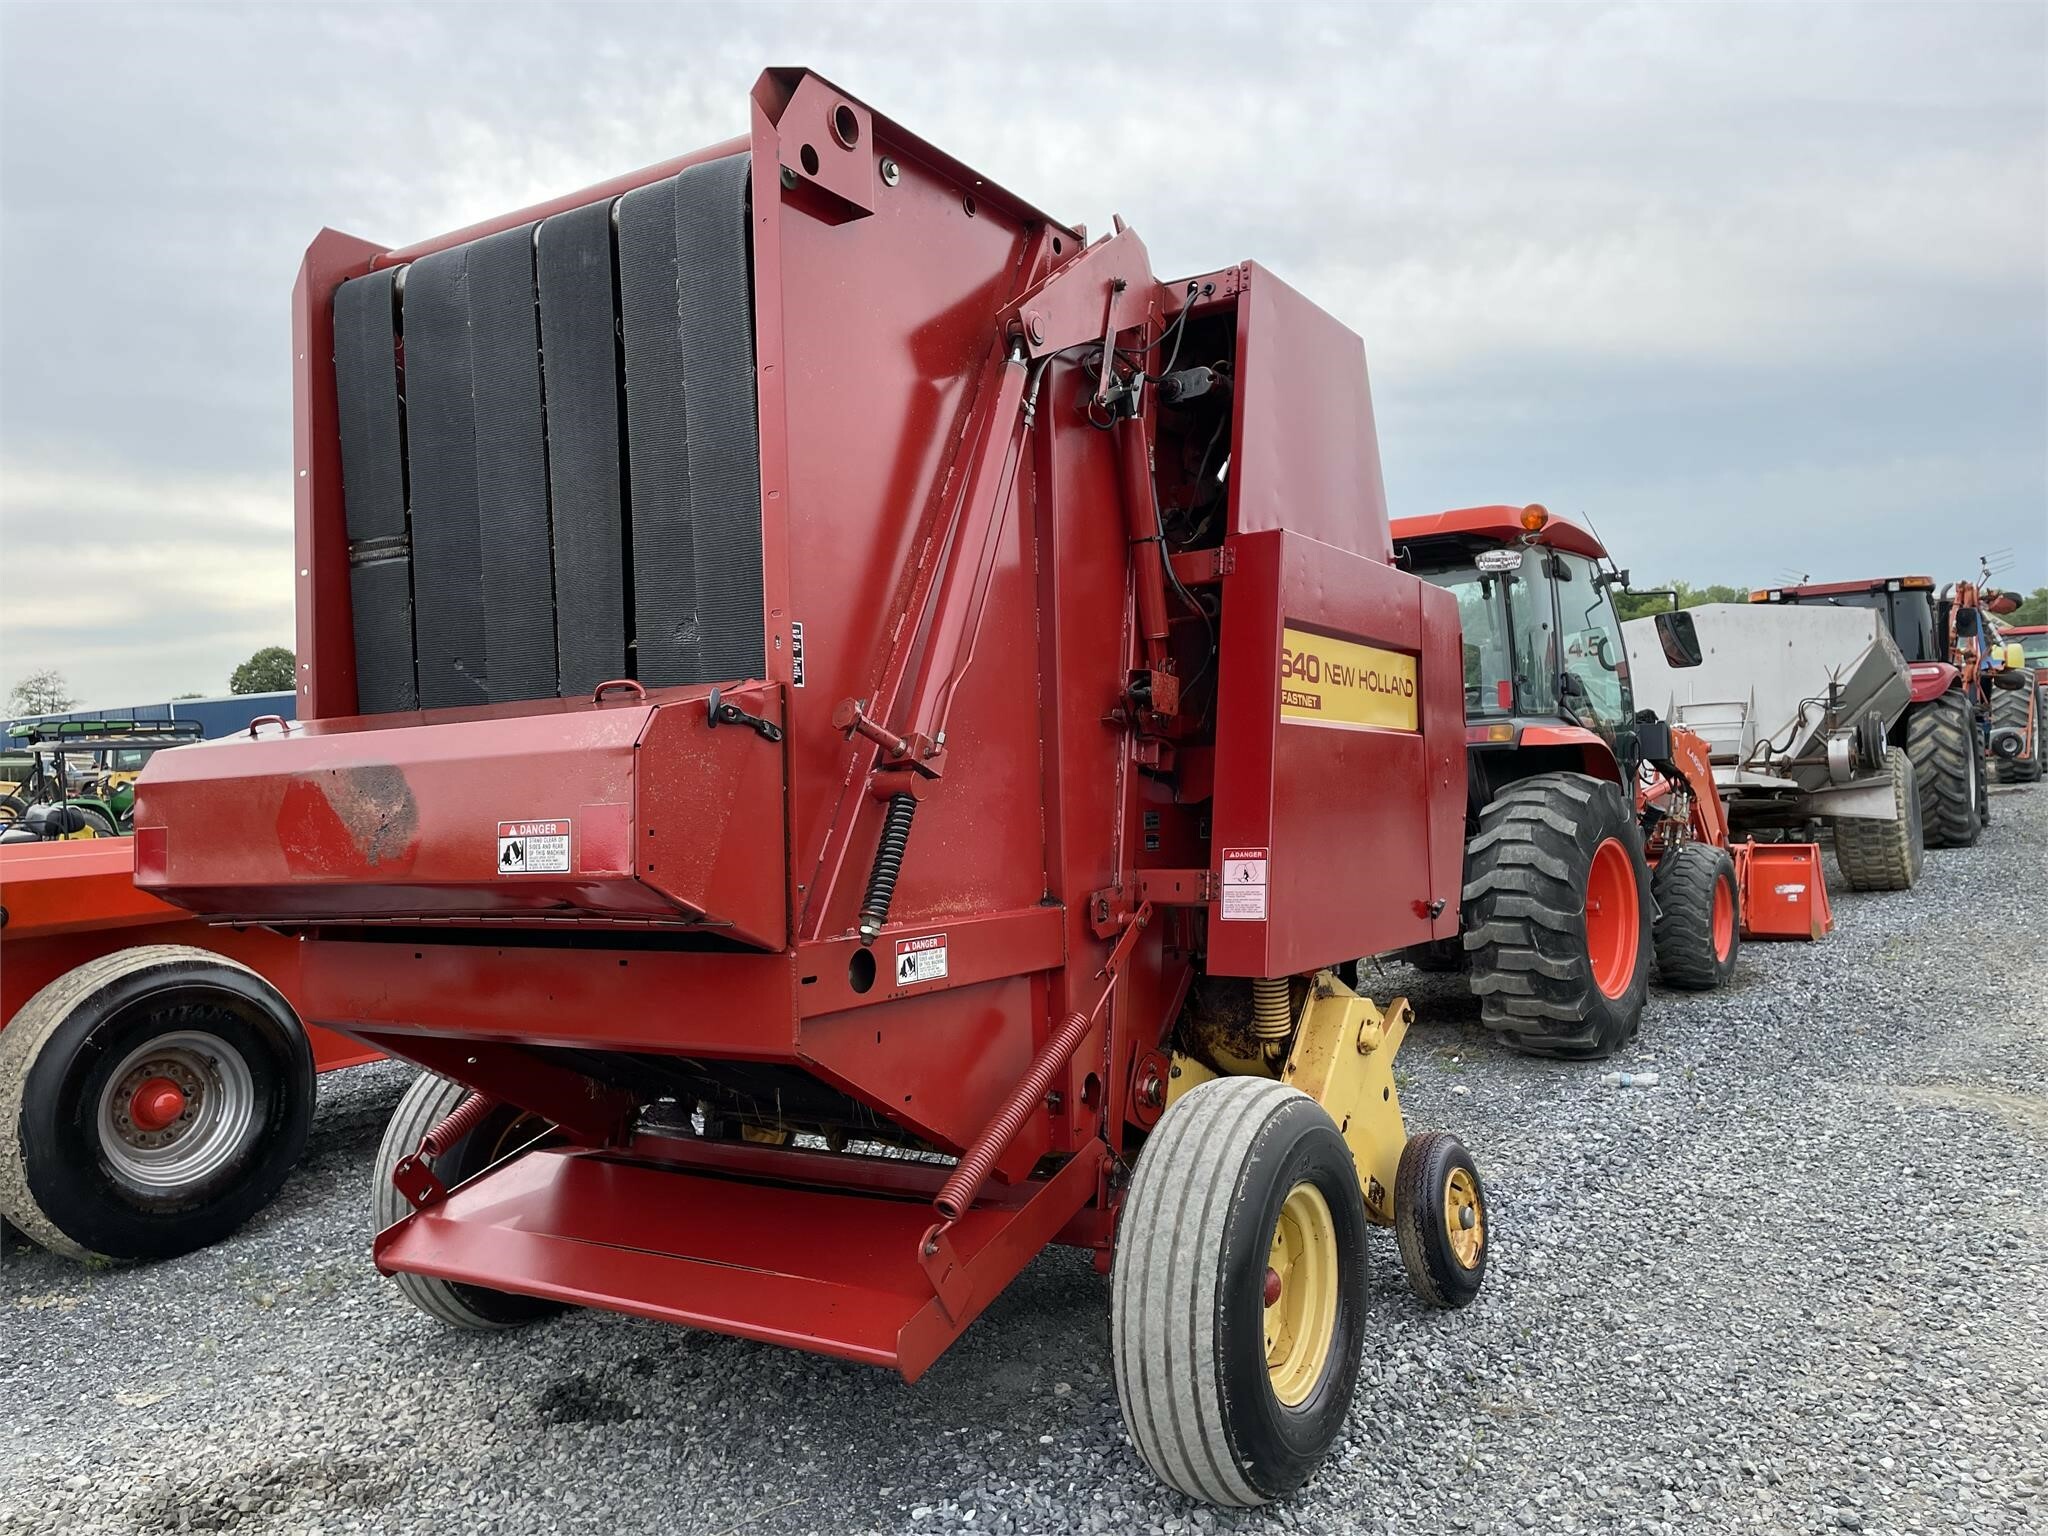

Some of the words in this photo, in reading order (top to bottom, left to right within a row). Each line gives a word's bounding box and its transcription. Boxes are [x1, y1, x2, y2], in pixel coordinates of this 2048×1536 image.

[1280, 648, 1320, 684] 640
[1324, 662, 1356, 688] NEW
[1358, 668, 1414, 698] HOLLAND
[1281, 690, 1318, 708] FASTNET
[520, 823, 557, 835] DANGER
[912, 938, 937, 950] DANGER
